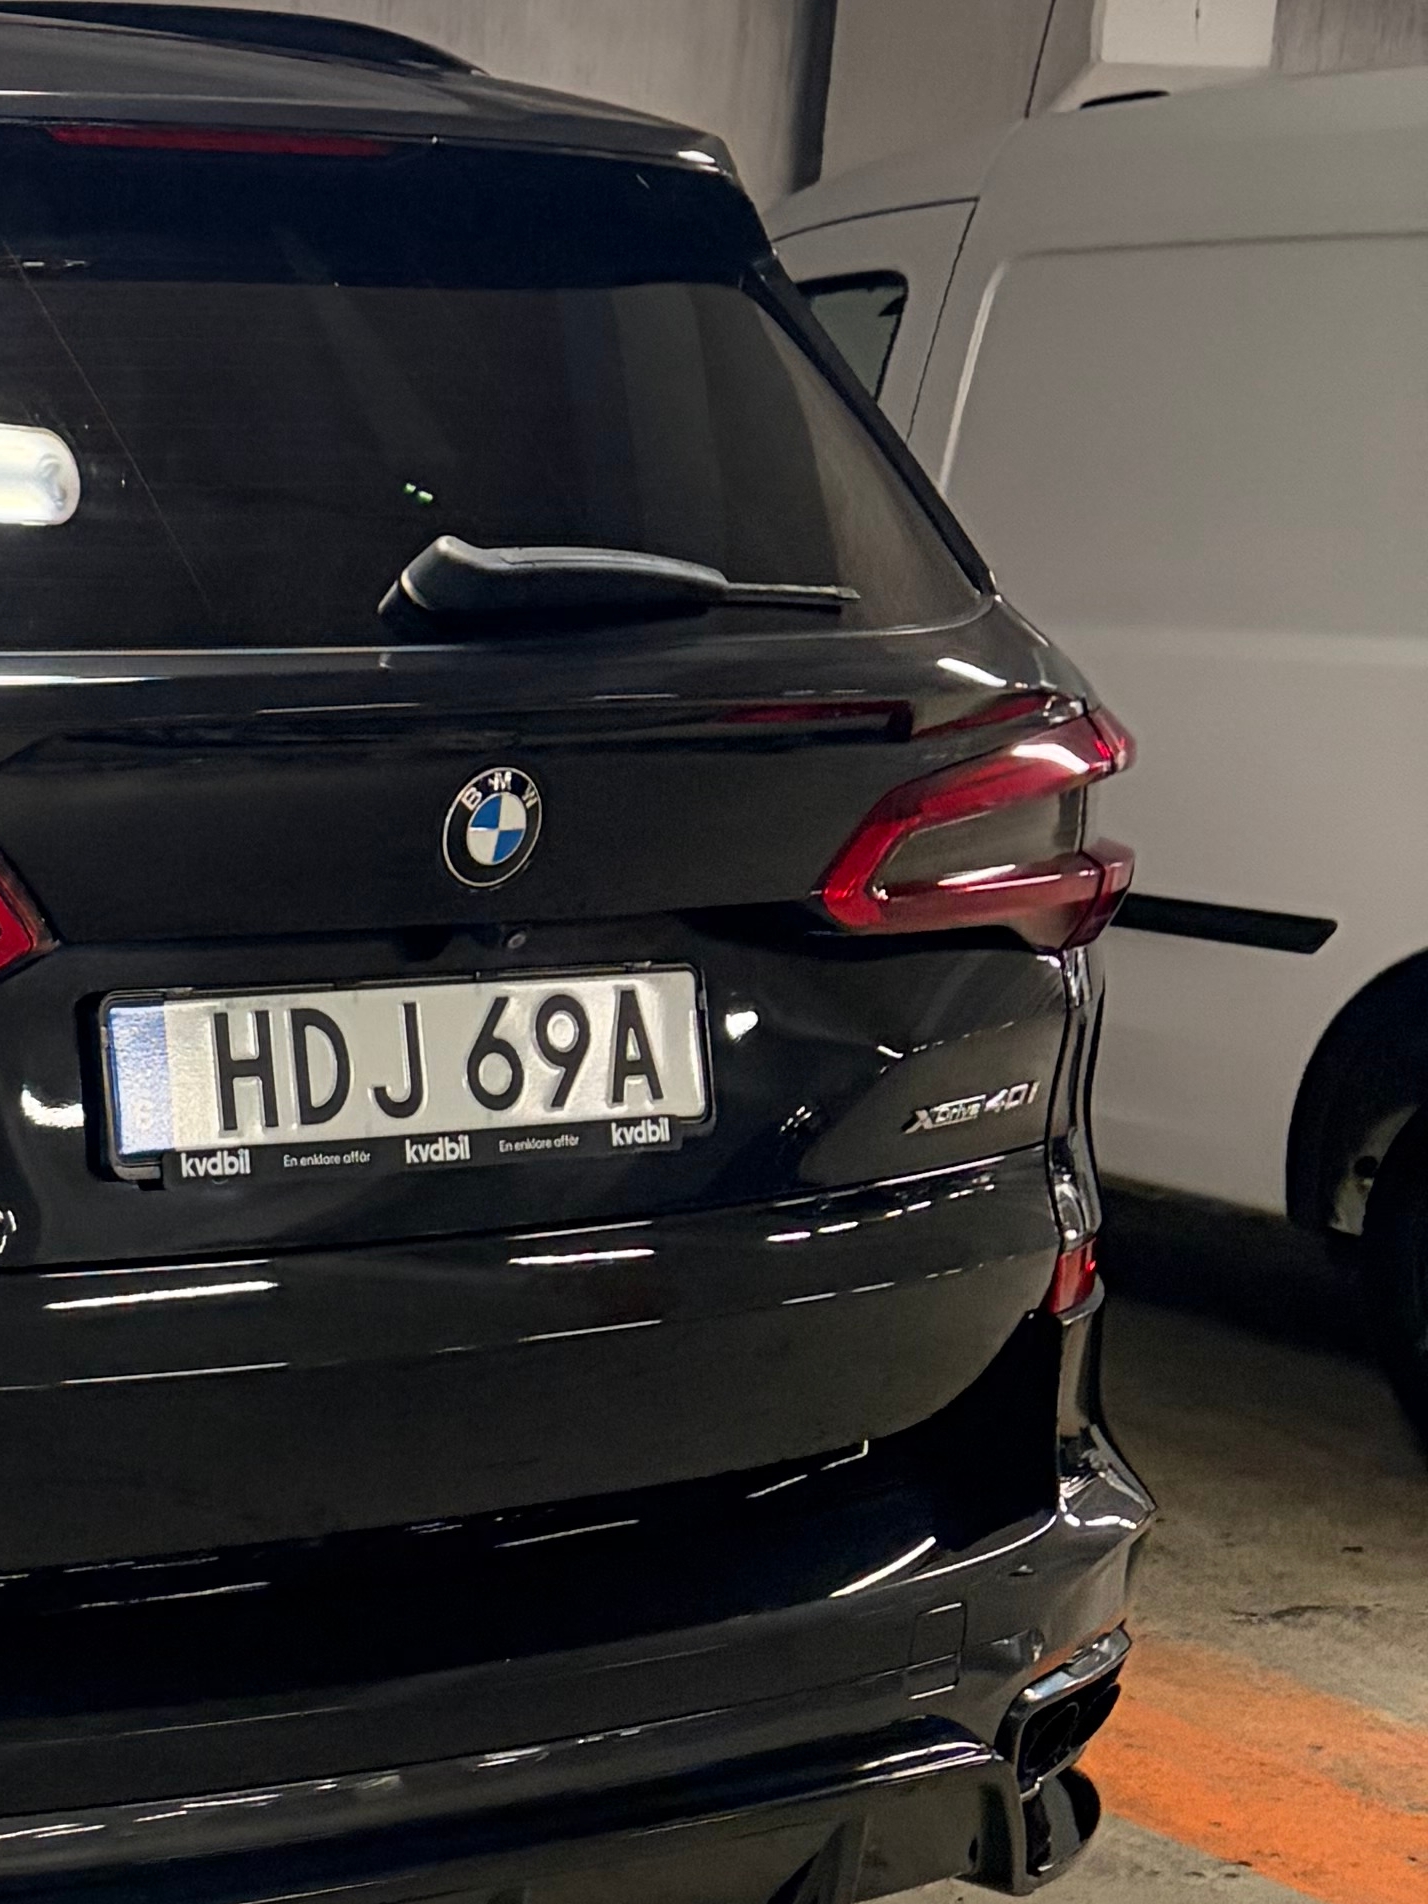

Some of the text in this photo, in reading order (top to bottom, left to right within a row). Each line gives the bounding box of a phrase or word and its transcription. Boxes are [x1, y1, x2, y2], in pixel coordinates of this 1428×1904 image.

[460, 771, 538, 812] BMW
[212, 987, 664, 1131] HDJ 69A
[180, 1148, 251, 1178] kvdbil
[283, 1154, 298, 1168] En
[405, 1134, 471, 1164] kvdbil
[499, 1139, 513, 1153] En
[611, 1116, 671, 1147] kvdbil
